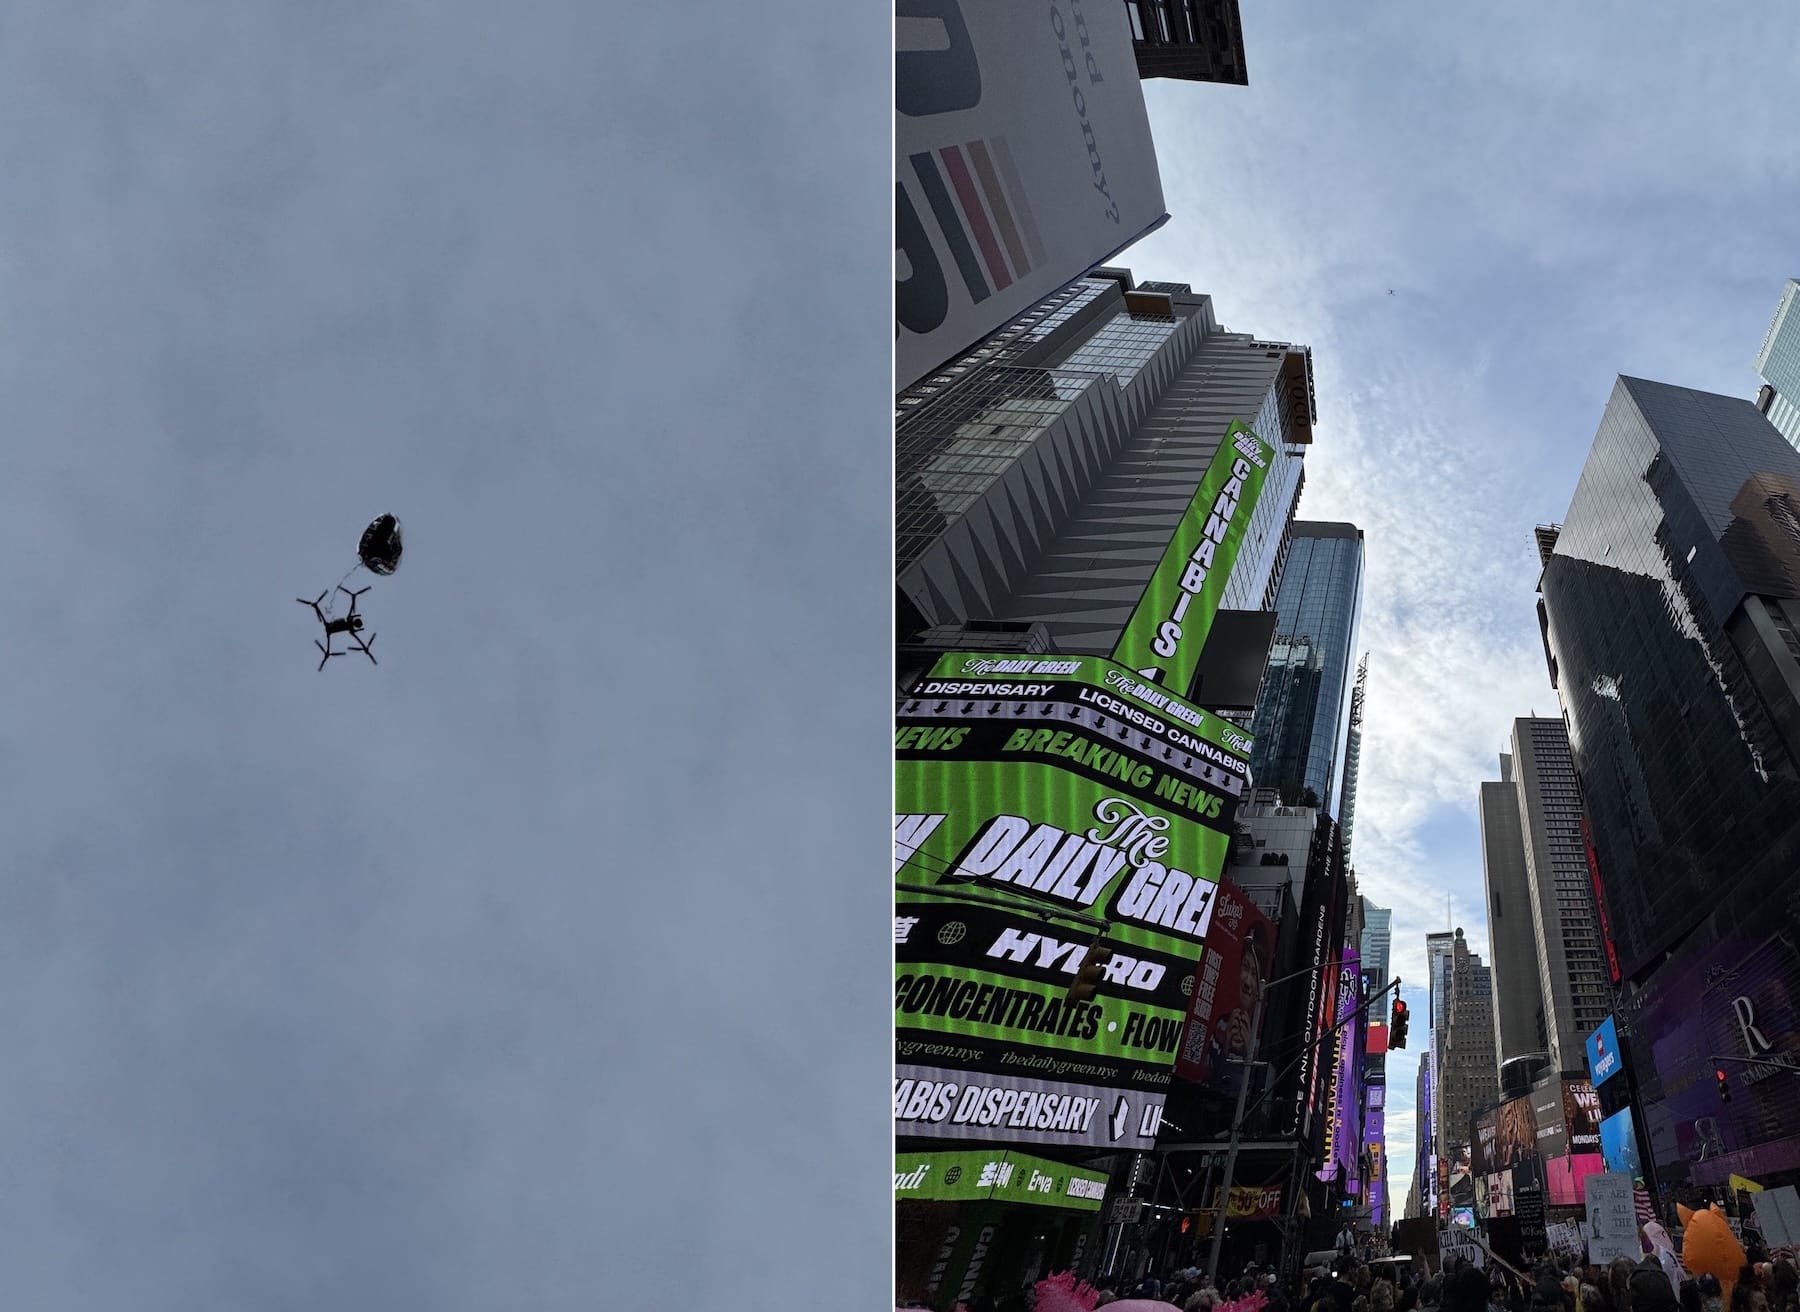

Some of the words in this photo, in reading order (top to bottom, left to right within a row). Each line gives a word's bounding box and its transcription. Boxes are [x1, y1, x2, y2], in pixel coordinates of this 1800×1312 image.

[1152, 457, 1251, 658] CANNABIS
[923, 682, 1056, 697] DISPENSARY
[961, 656, 997, 678] The
[993, 659, 1038, 675] DAILY
[1034, 660, 1083, 676] GREEN
[1105, 669, 1137, 696] The
[1130, 684, 1170, 711] DAILY
[1165, 701, 1205, 728] GREEN
[1078, 687, 1166, 733] LICENSED
[1166, 729, 1247, 774] CANNABIS
[1002, 728, 1153, 789] BREAKING
[1154, 774, 1225, 819] NEWS
[1087, 797, 1170, 868] The
[952, 814, 1127, 907] DAILY
[1115, 861, 1219, 939] GRE
[1304, 968, 1320, 1043] OUTDOOR
[1313, 904, 1327, 966] GARDENS
[896, 974, 1103, 1041] CONCENTRATES
[1731, 995, 1775, 1058] R
[999, 1050, 1119, 1080] thedailygreen.nyc
[896, 1078, 954, 1122] ABIS
[953, 1084, 1101, 1133] DISPENSARY
[1139, 1103, 1164, 1136] LI
[1026, 1168, 1053, 1194] Erva
[1257, 1190, 1281, 1210] OFF
[1610, 1189, 1629, 1200] ARE
[1612, 1204, 1630, 1215] ALL
[1612, 1217, 1632, 1228] THE
